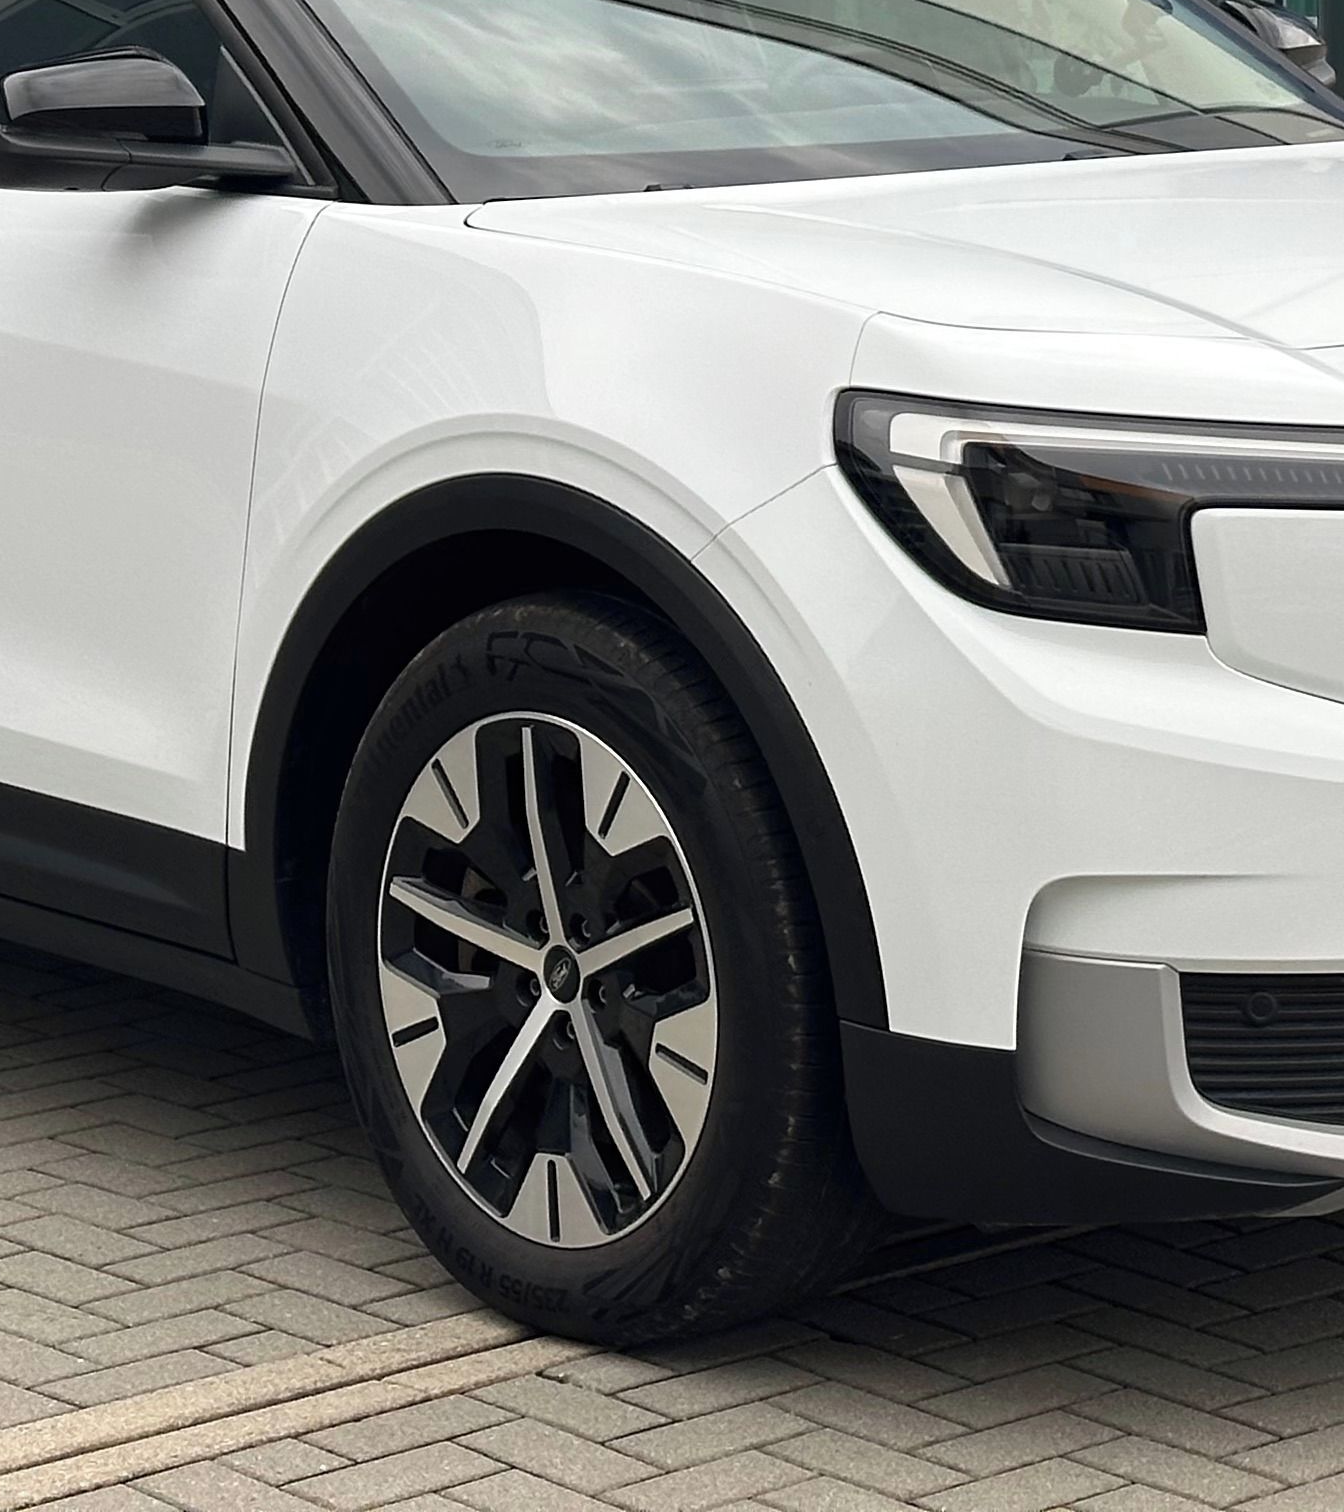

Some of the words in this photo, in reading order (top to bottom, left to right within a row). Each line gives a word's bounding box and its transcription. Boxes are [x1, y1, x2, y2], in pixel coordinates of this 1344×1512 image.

[436, 1225, 454, 1254] H
[455, 1245, 476, 1274] 19
[479, 1264, 494, 1290] R
[499, 1272, 570, 1313] 235/55
